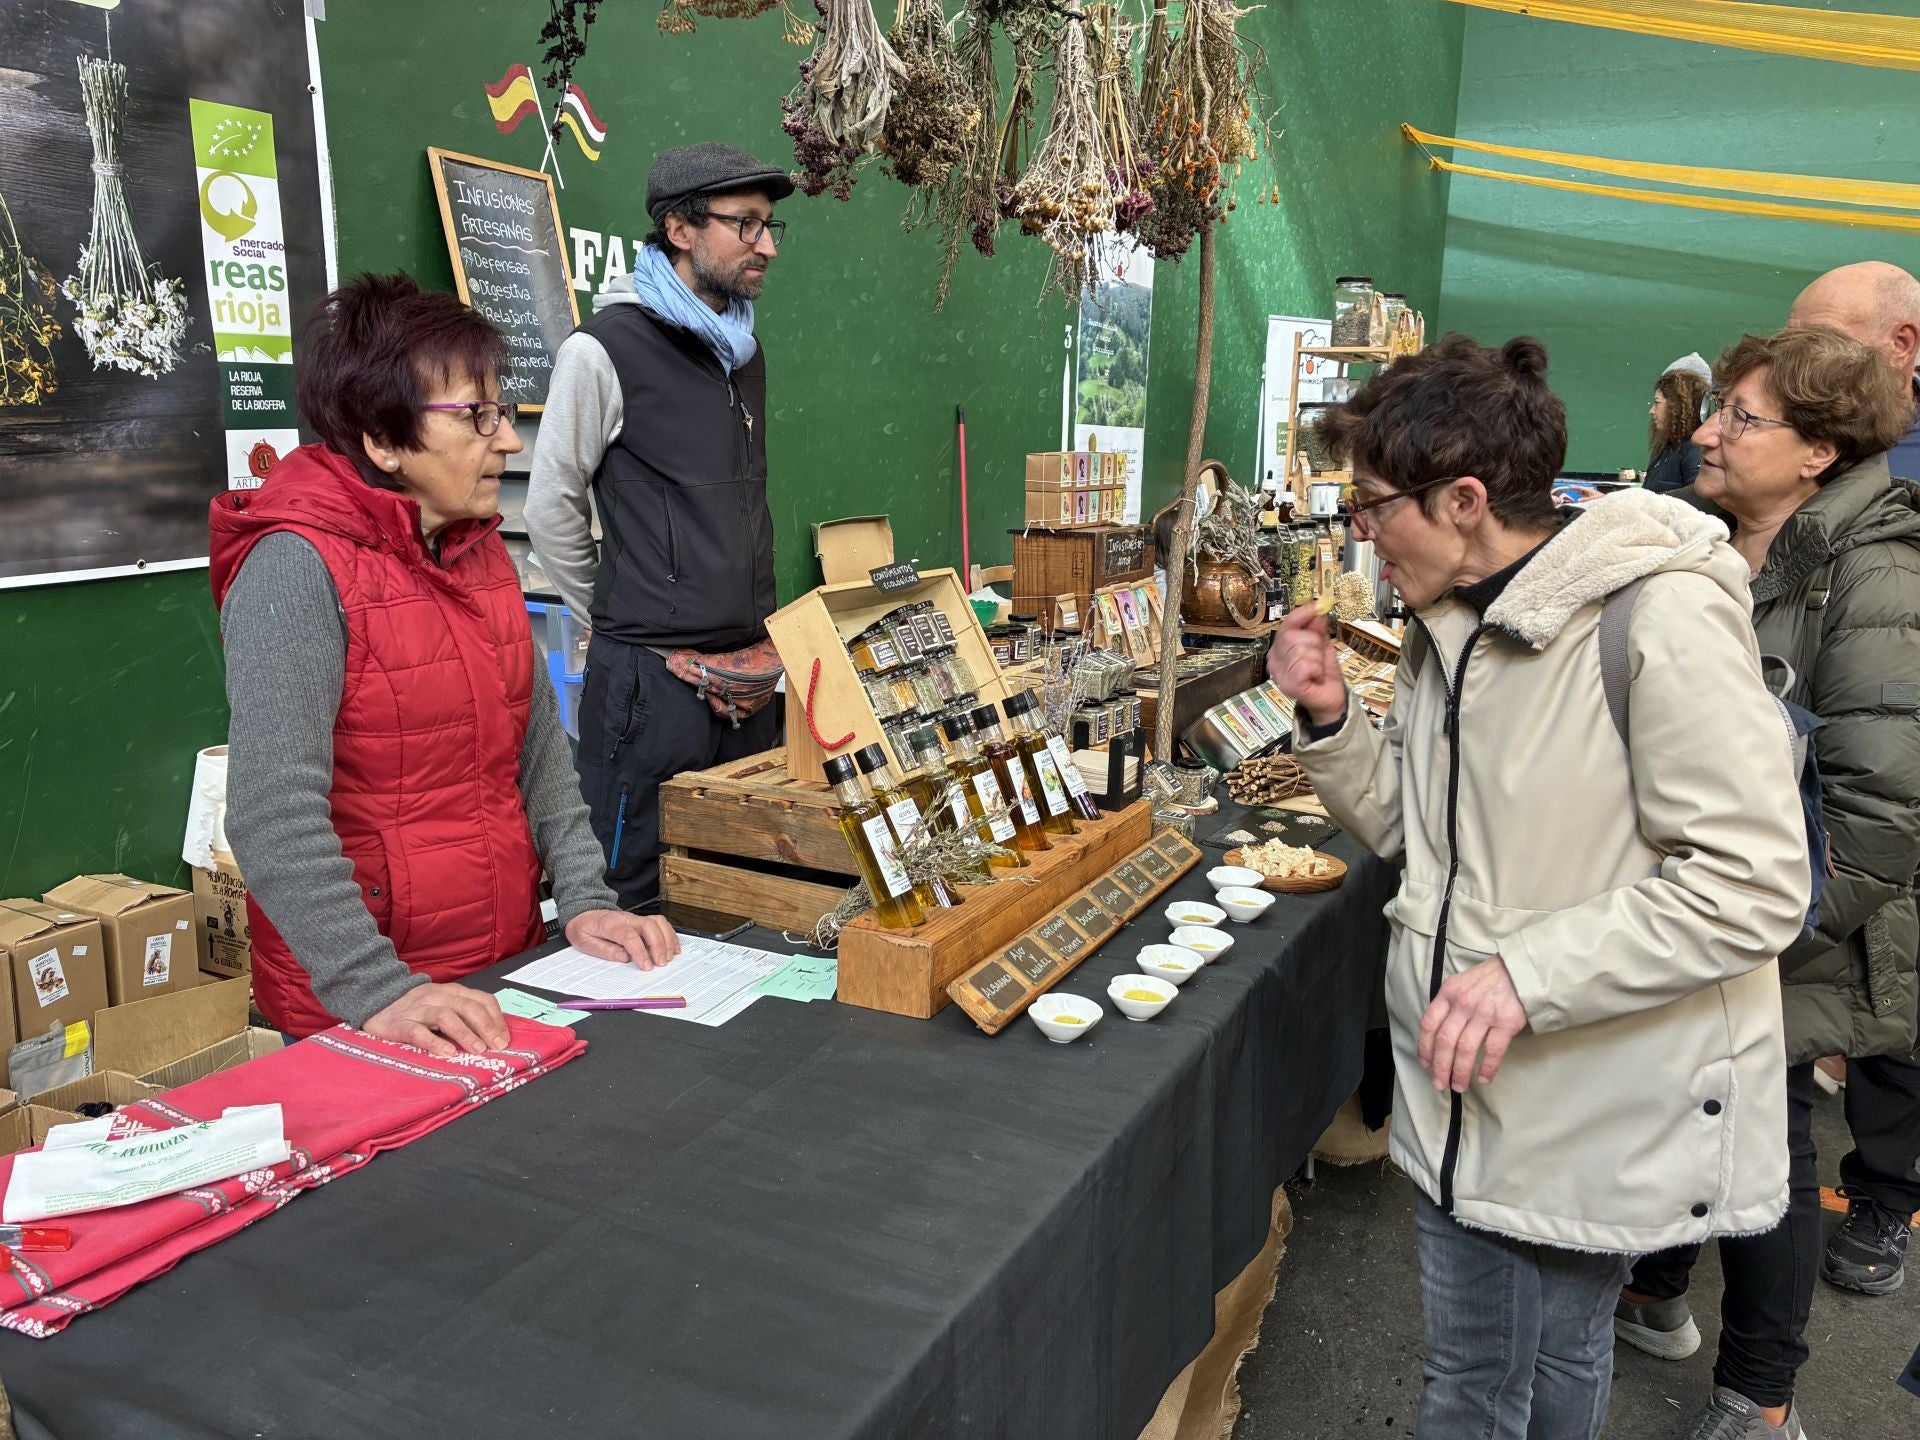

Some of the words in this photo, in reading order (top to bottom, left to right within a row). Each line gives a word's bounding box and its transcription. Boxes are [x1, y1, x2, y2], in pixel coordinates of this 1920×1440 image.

[232, 245, 266, 259] Social
[240, 239, 285, 251] mercado
[210, 259, 285, 292] reas
[214, 291, 282, 333] rioja
[1064, 324, 1073, 349] 3
[229, 371, 240, 382] LA
[241, 371, 264, 384] RIOJA,
[230, 385, 263, 396] RESERVA
[232, 400, 243, 410] DE
[243, 400, 253, 410] LA
[253, 400, 286, 410] BIOSFERA
[872, 564, 913, 582] CONDIMENTOS
[1060, 937, 1083, 955] TOMATE
[1025, 957, 1052, 979] LAUREL
